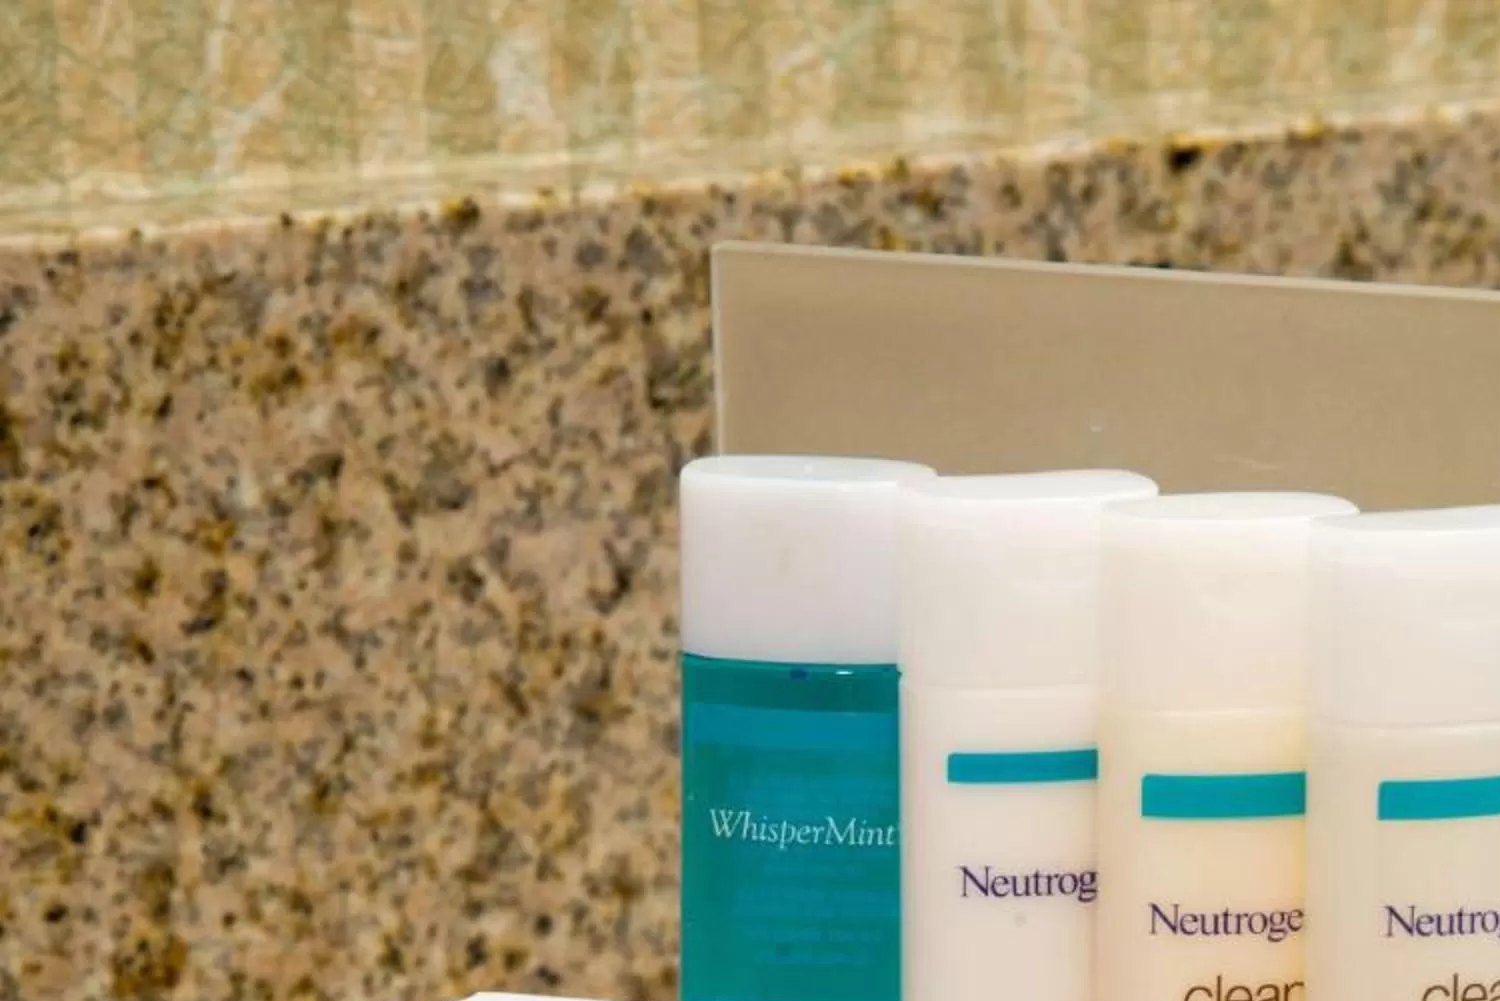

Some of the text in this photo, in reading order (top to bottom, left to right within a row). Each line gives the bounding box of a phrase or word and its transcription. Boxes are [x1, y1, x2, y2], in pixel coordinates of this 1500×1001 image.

[709, 808, 896, 851] WhisperMint
[957, 865, 1098, 903] Neutrog
[1148, 903, 1304, 942] Neutroge
